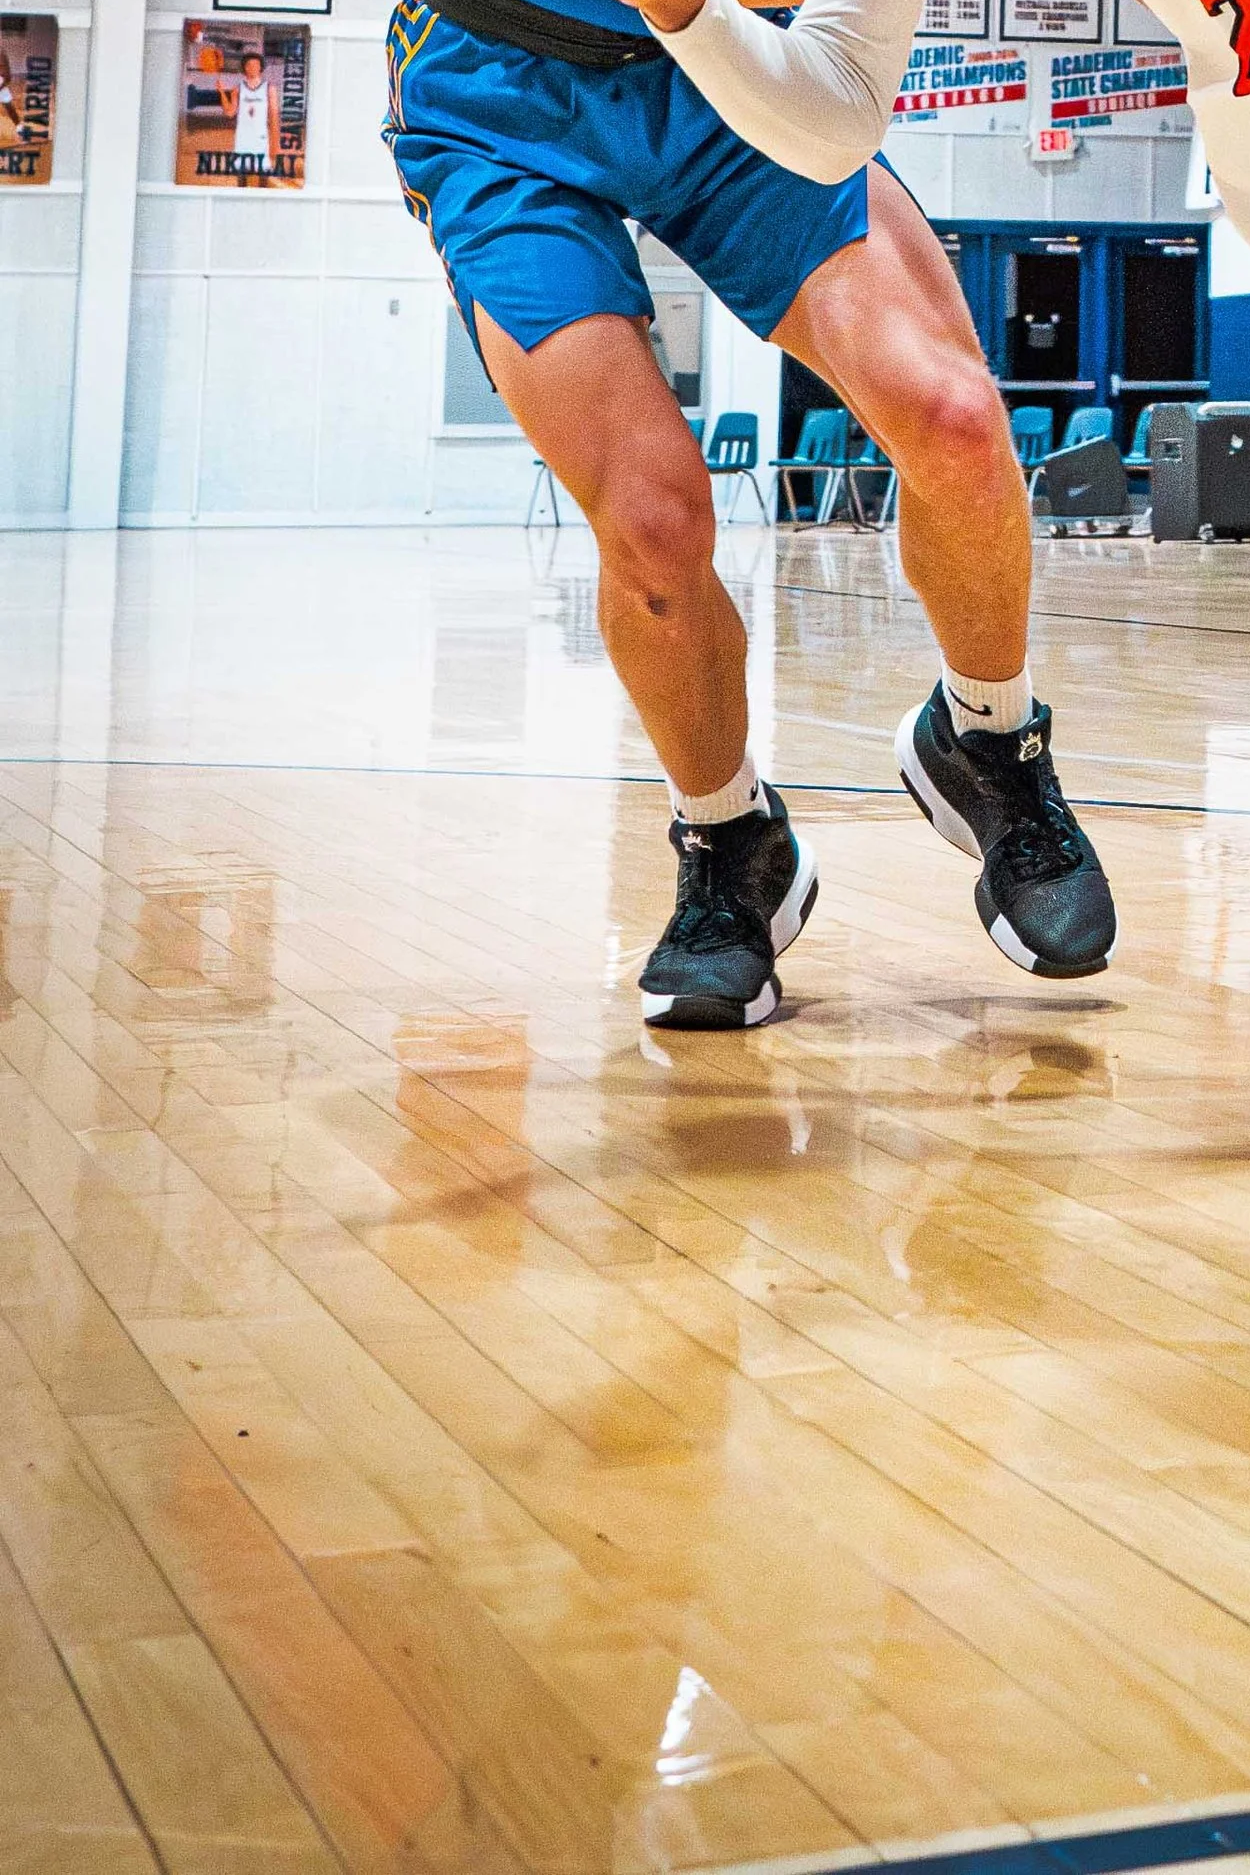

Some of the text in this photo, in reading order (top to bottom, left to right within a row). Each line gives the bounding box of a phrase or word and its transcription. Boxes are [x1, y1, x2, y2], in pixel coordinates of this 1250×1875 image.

[931, 60, 1027, 88] CHAMPIONS
[1051, 51, 1132, 77] ACADEMIC
[1052, 76, 1096, 99] STATE
[196, 151, 298, 177] NIKOLAI
